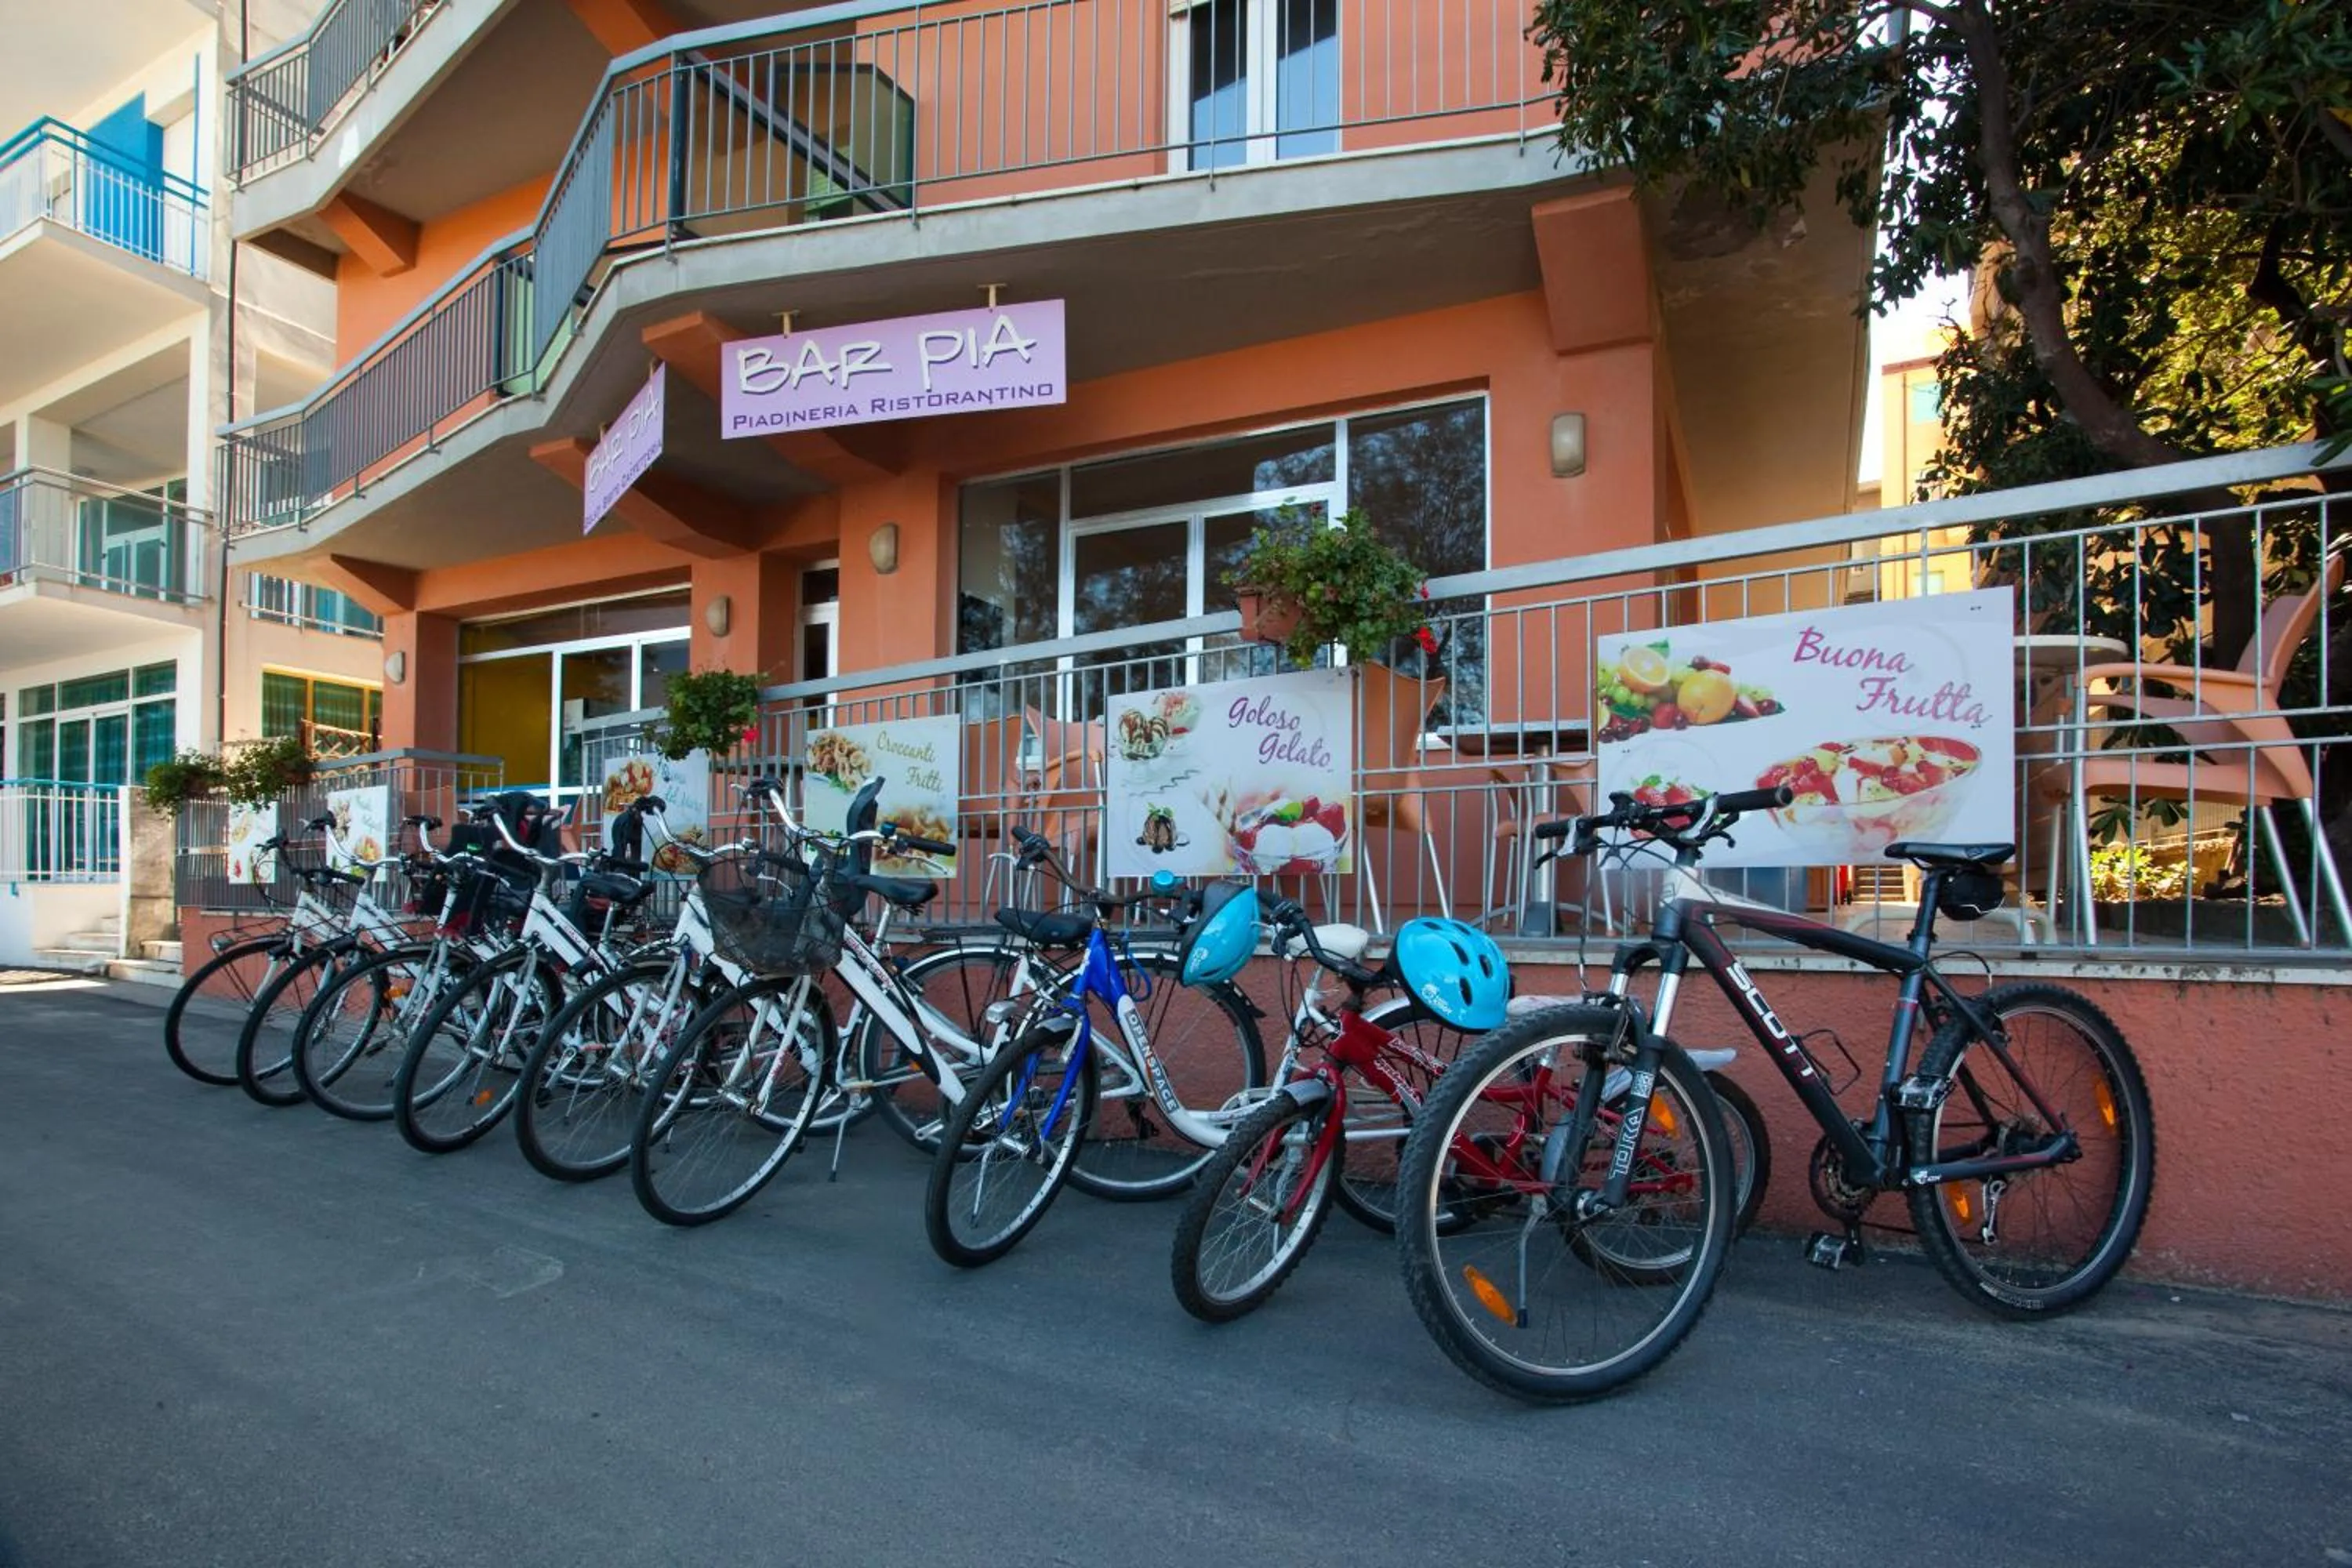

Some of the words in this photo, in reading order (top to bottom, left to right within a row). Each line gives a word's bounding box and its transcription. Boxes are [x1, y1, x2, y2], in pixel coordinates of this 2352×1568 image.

[736, 339, 893, 395] BAR
[917, 314, 1038, 392] PIA
[732, 403, 858, 430] PIADINERIA
[871, 383, 1054, 415] RISTORANTINO
[1793, 626, 1915, 673] Buona
[1229, 695, 1301, 731] Goloso
[1856, 677, 1993, 724] Frutta
[877, 730, 935, 764] Croccanti
[1258, 731, 1331, 768] Gelato
[1726, 962, 1814, 1077] SCOTT
